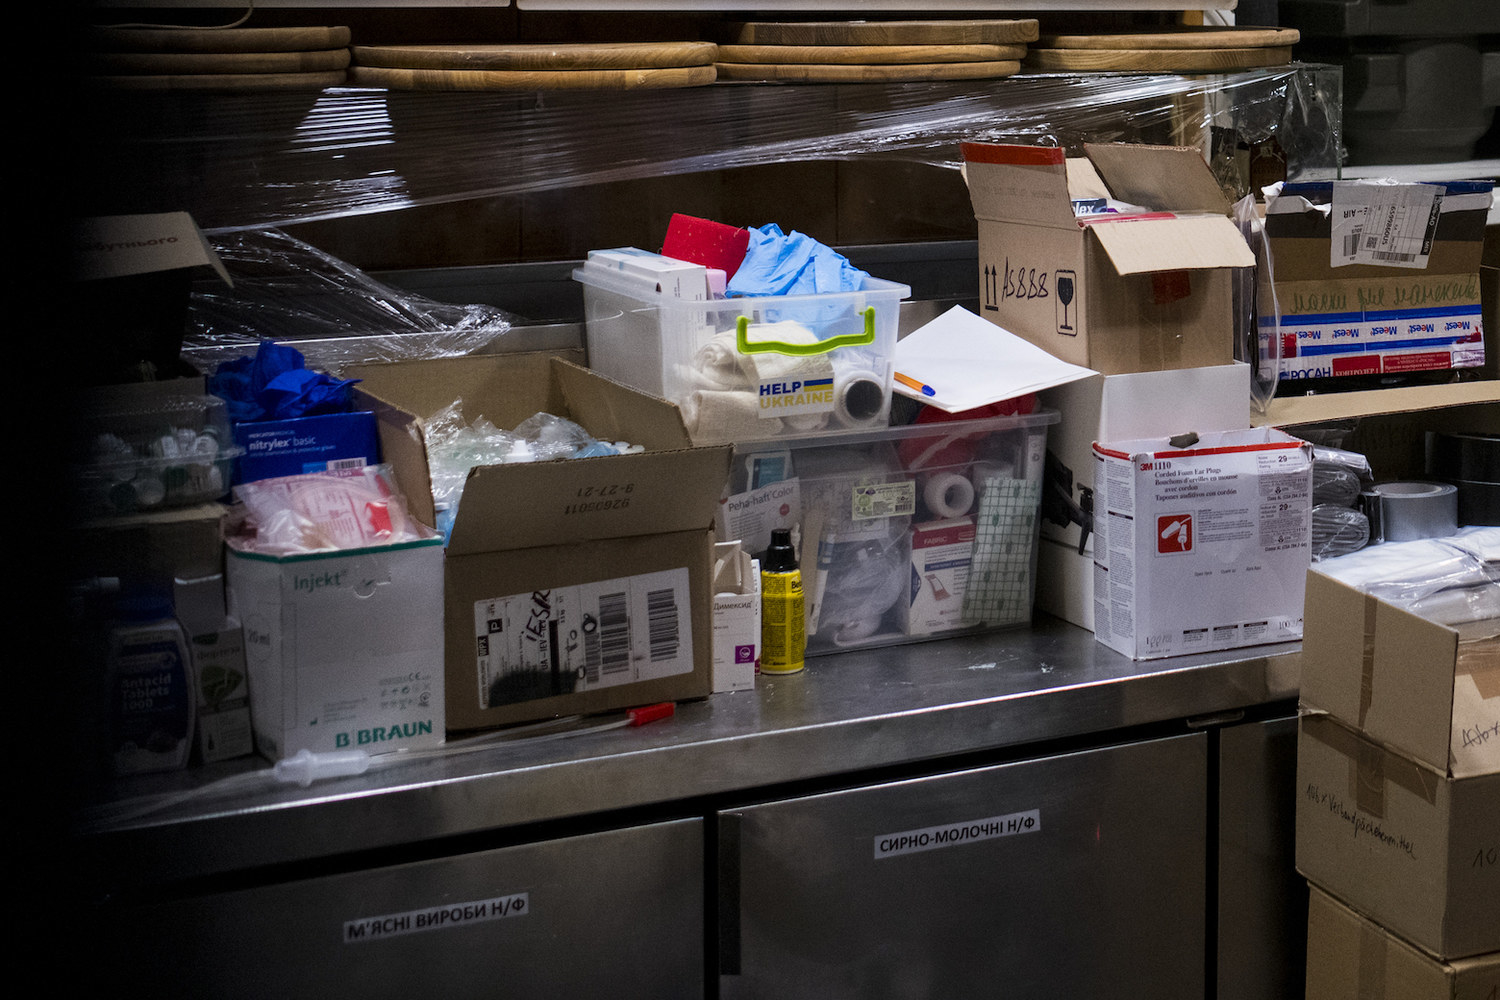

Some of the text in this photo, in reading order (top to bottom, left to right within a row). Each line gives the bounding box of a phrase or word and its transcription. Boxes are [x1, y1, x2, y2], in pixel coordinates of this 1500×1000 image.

[1072, 201, 1095, 217] lex
[1332, 328, 1359, 338] Meest
[1371, 326, 1397, 336] Meest
[1408, 323, 1434, 333] Meest
[760, 381, 802, 396] HELP
[760, 391, 833, 409] UKRAINE
[249, 436, 317, 452] nitrylex basic
[1278, 455, 1288, 463] 29
[1140, 461, 1171, 472] 3M 1110
[1155, 466, 1222, 478] Corded Foam Ear Plugs
[577, 483, 635, 497] 9-27-21
[772, 485, 795, 499] Color
[1155, 494, 1179, 502] Tapones
[1180, 490, 1206, 499] auditivos
[1279, 503, 1288, 511] 29
[294, 573, 341, 592] Injekt
[713, 600, 752, 611] Димексид
[491, 622, 498, 631] P
[480, 637, 489, 656] WPX
[122, 687, 170, 699] Tablets
[336, 719, 433, 748] B BRAUN
[880, 816, 1035, 852] СИРНО-МОЛОЧНІ Н/Ф
[348, 897, 525, 939] М'ЯСНІ ВИРОБИ Н/Ф
